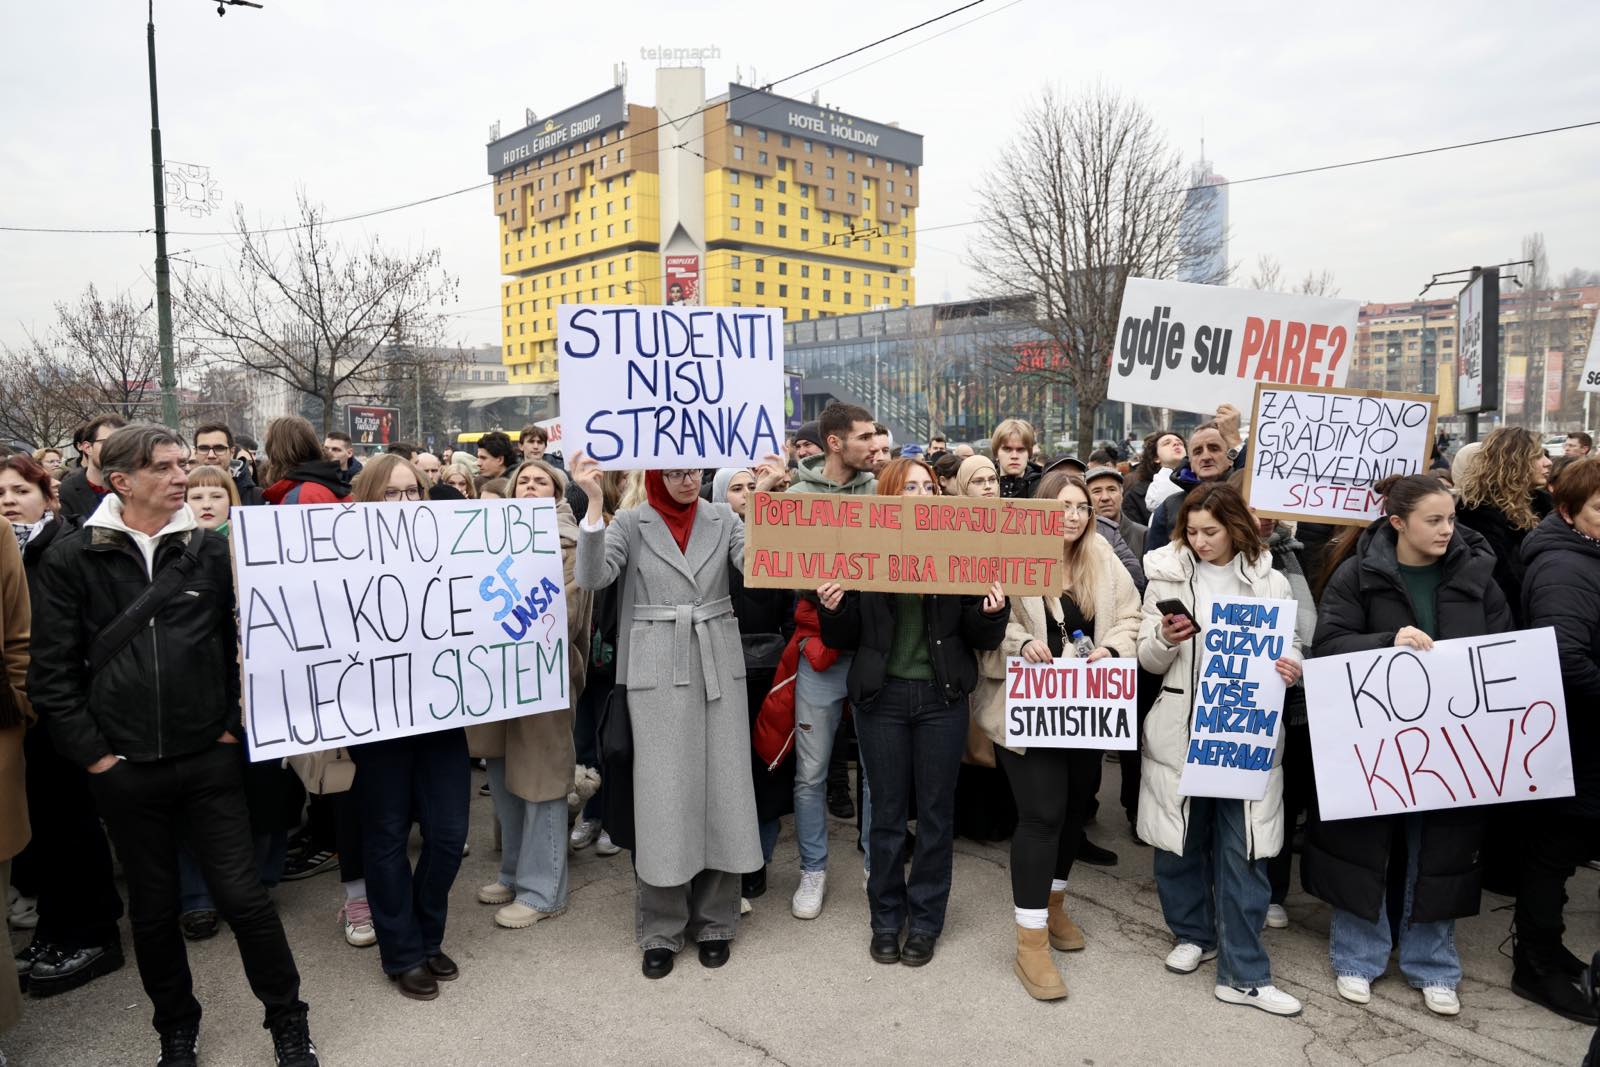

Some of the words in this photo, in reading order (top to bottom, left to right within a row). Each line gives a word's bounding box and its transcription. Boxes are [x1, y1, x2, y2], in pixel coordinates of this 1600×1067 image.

[640, 44, 721, 60] telemach
[503, 144, 530, 165] HOTEL
[533, 128, 568, 152] EUROPE
[570, 114, 601, 137] GROUP
[788, 112, 827, 133] HOTEL
[831, 123, 879, 147] HOLIDAY
[564, 308, 773, 361] STUDENTI
[1117, 306, 1186, 381] gdje
[1190, 325, 1233, 376] su
[1236, 316, 1348, 387] PARE?
[627, 359, 725, 405] NISU
[1261, 392, 1428, 428] ZAJEDNO
[585, 401, 780, 462] STRANKA
[1258, 421, 1399, 454] GRADIMO
[754, 492, 863, 528] POPLAVE
[869, 503, 902, 530] NE
[914, 503, 997, 534] BIRAJU
[1000, 501, 1065, 536] ŽRTVE
[1283, 483, 1389, 516] SISTEM
[239, 502, 439, 567] LIJEČIMO
[450, 504, 556, 555] ZUBE
[751, 549, 793, 578] ALI
[797, 552, 881, 580] VLAST
[888, 554, 938, 582] BIRA
[949, 555, 1057, 587] PRIORITET
[478, 554, 523, 622] SF
[245, 579, 332, 660] ALI
[342, 573, 409, 643] KO
[421, 565, 474, 640] ĆE
[500, 576, 561, 641] UNSA
[1211, 602, 1280, 630] MRZIM
[1205, 626, 1284, 661] GUŽVU
[1008, 661, 1079, 699] ŽIVOTI
[1086, 667, 1136, 700] NISU
[1204, 654, 1249, 680] ALI
[1345, 651, 1431, 729] KO
[1447, 639, 1527, 719] JE
[249, 650, 414, 748] LIJEČITI
[429, 637, 565, 721] SISTEM
[1201, 680, 1260, 708] VIŠE
[1009, 705, 1131, 738] STATISTIKA
[1194, 705, 1279, 737] MRZIM
[1187, 739, 1276, 772] NEPRAVDU
[1353, 700, 1557, 811] KRIV?
